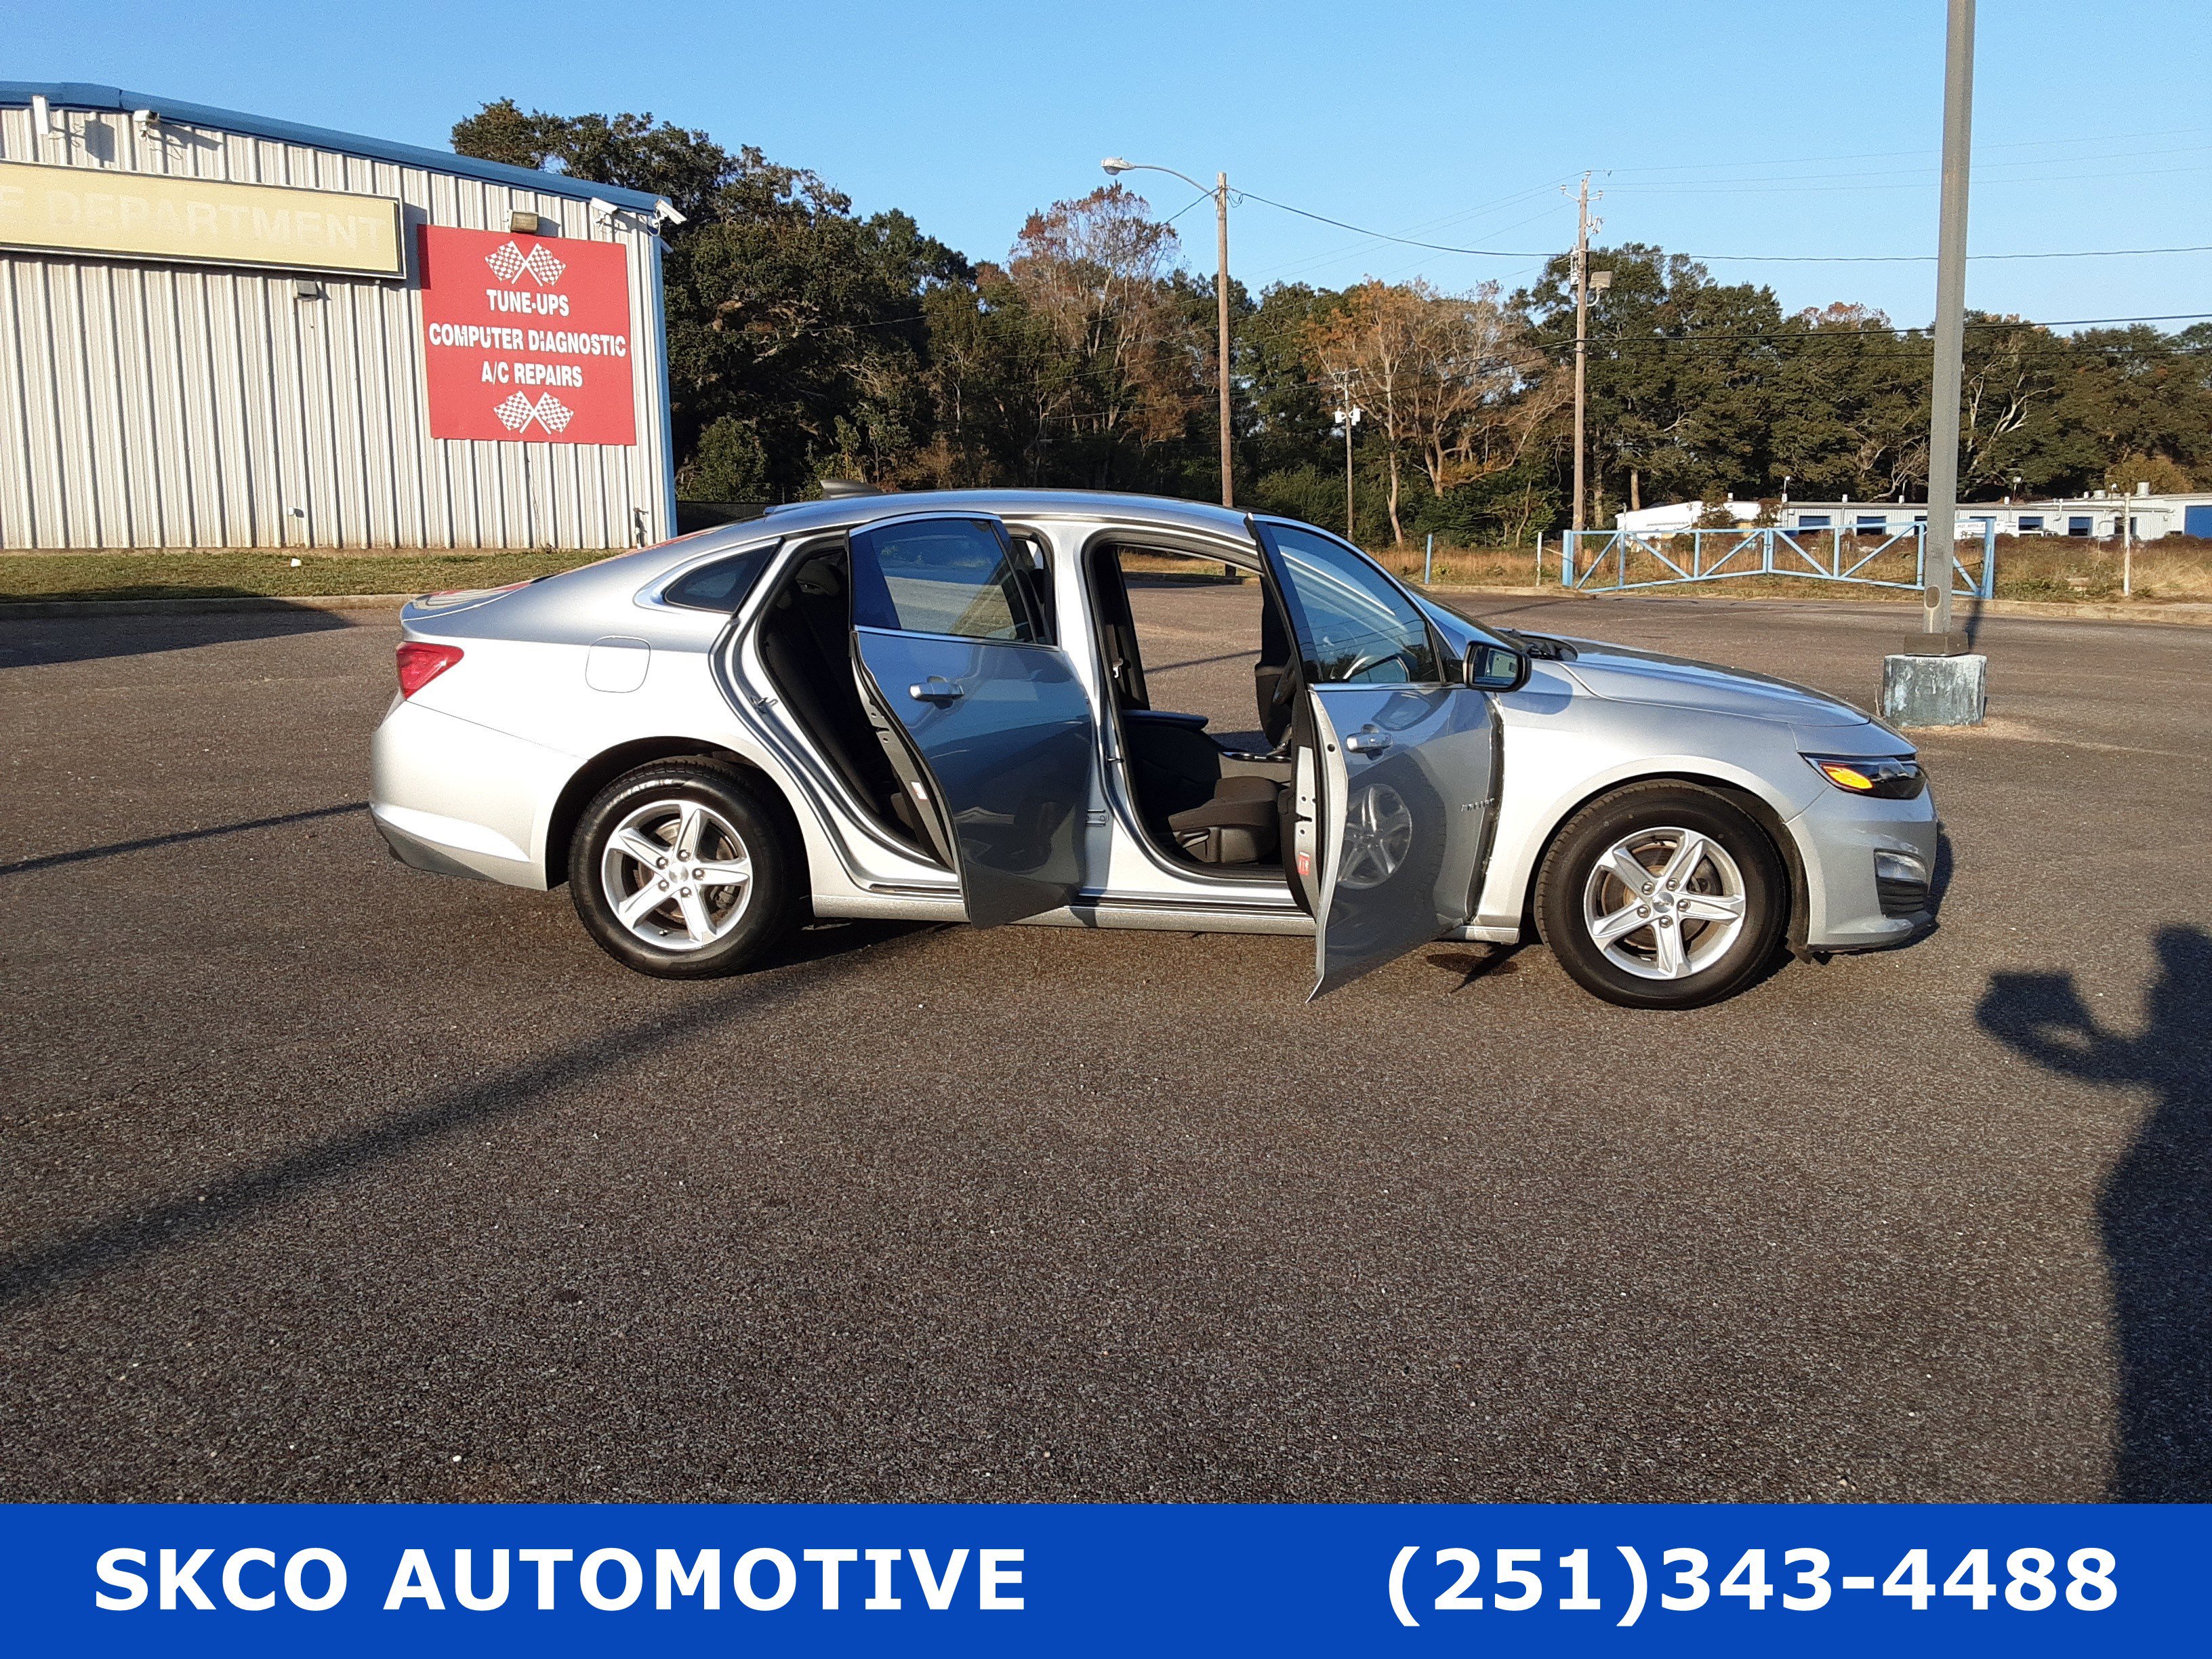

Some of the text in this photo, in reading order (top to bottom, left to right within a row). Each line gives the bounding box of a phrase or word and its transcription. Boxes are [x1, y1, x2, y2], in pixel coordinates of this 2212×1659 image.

[46, 190, 387, 251] DEPARTMENT
[486, 289, 570, 316] TUNE-UPS
[429, 323, 626, 357] COMPUTER DIAGNOSTIC
[481, 361, 583, 388] A/C REPAIRS
